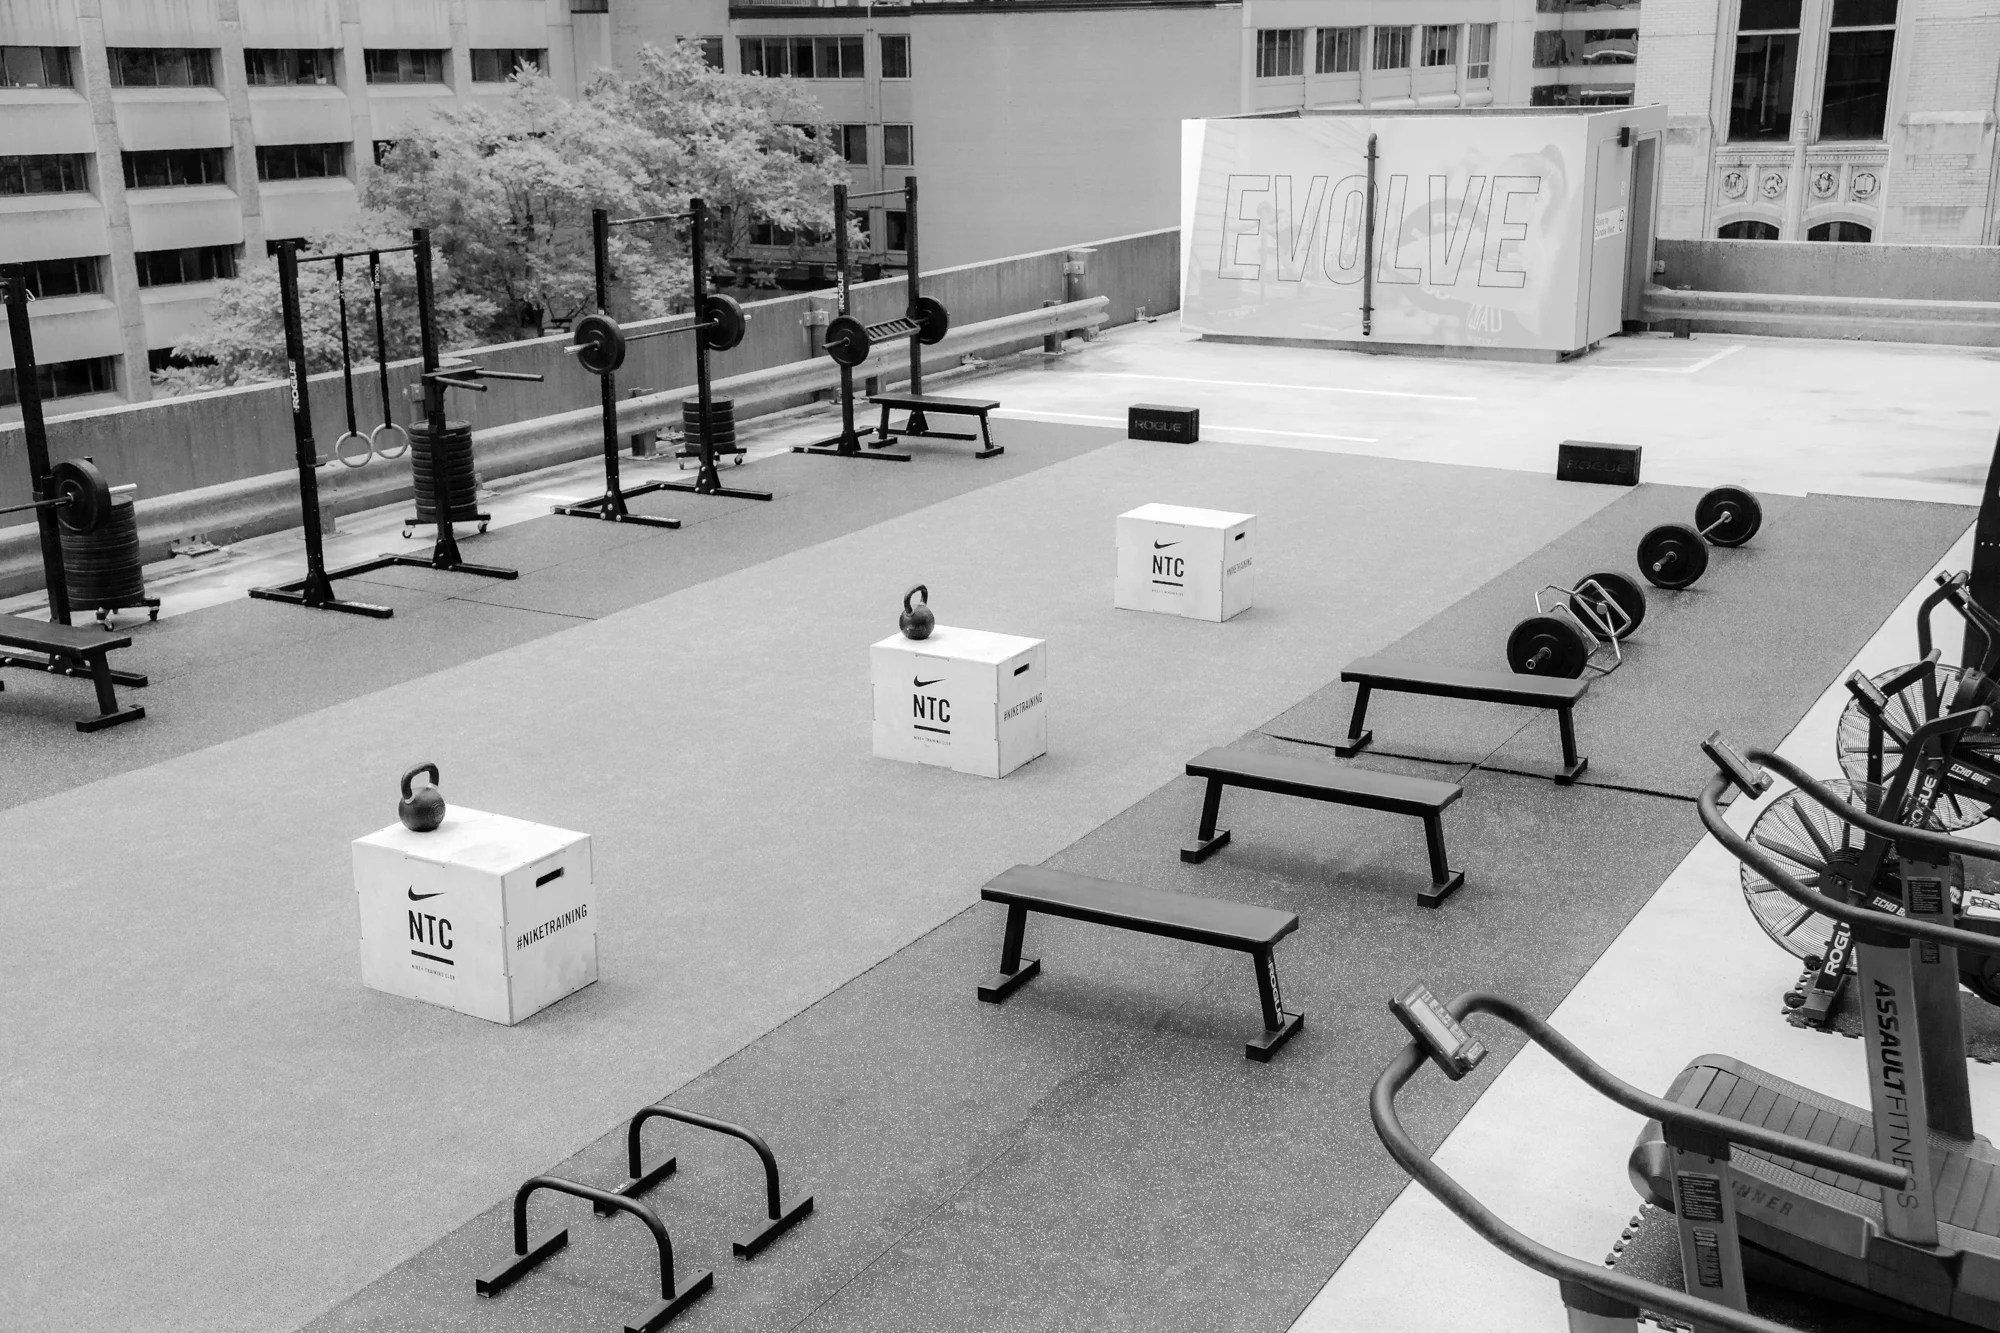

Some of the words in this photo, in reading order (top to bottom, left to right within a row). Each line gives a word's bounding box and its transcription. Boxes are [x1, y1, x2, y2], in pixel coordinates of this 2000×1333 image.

[1217, 174, 1541, 288] EVOLVE
[837, 271, 845, 310] ROGUE
[288, 360, 300, 409] ROGUE
[1134, 419, 1183, 433] ROGUE
[1566, 458, 1630, 473] ROGUE
[1152, 554, 1185, 578] NTC
[913, 693, 951, 723] NTC
[1003, 692, 1043, 722] #NIKETRAINING
[1950, 763, 1973, 778] ECHO
[1970, 772, 1991, 786] BIKE
[1872, 896, 1898, 912] ECHO
[408, 909, 454, 950] NTC
[516, 903, 588, 951] #NIKETRAINING
[1824, 922, 1851, 977] ROGU
[1268, 962, 1284, 1025] ROGUE
[1732, 1181, 1794, 1217] NNER
